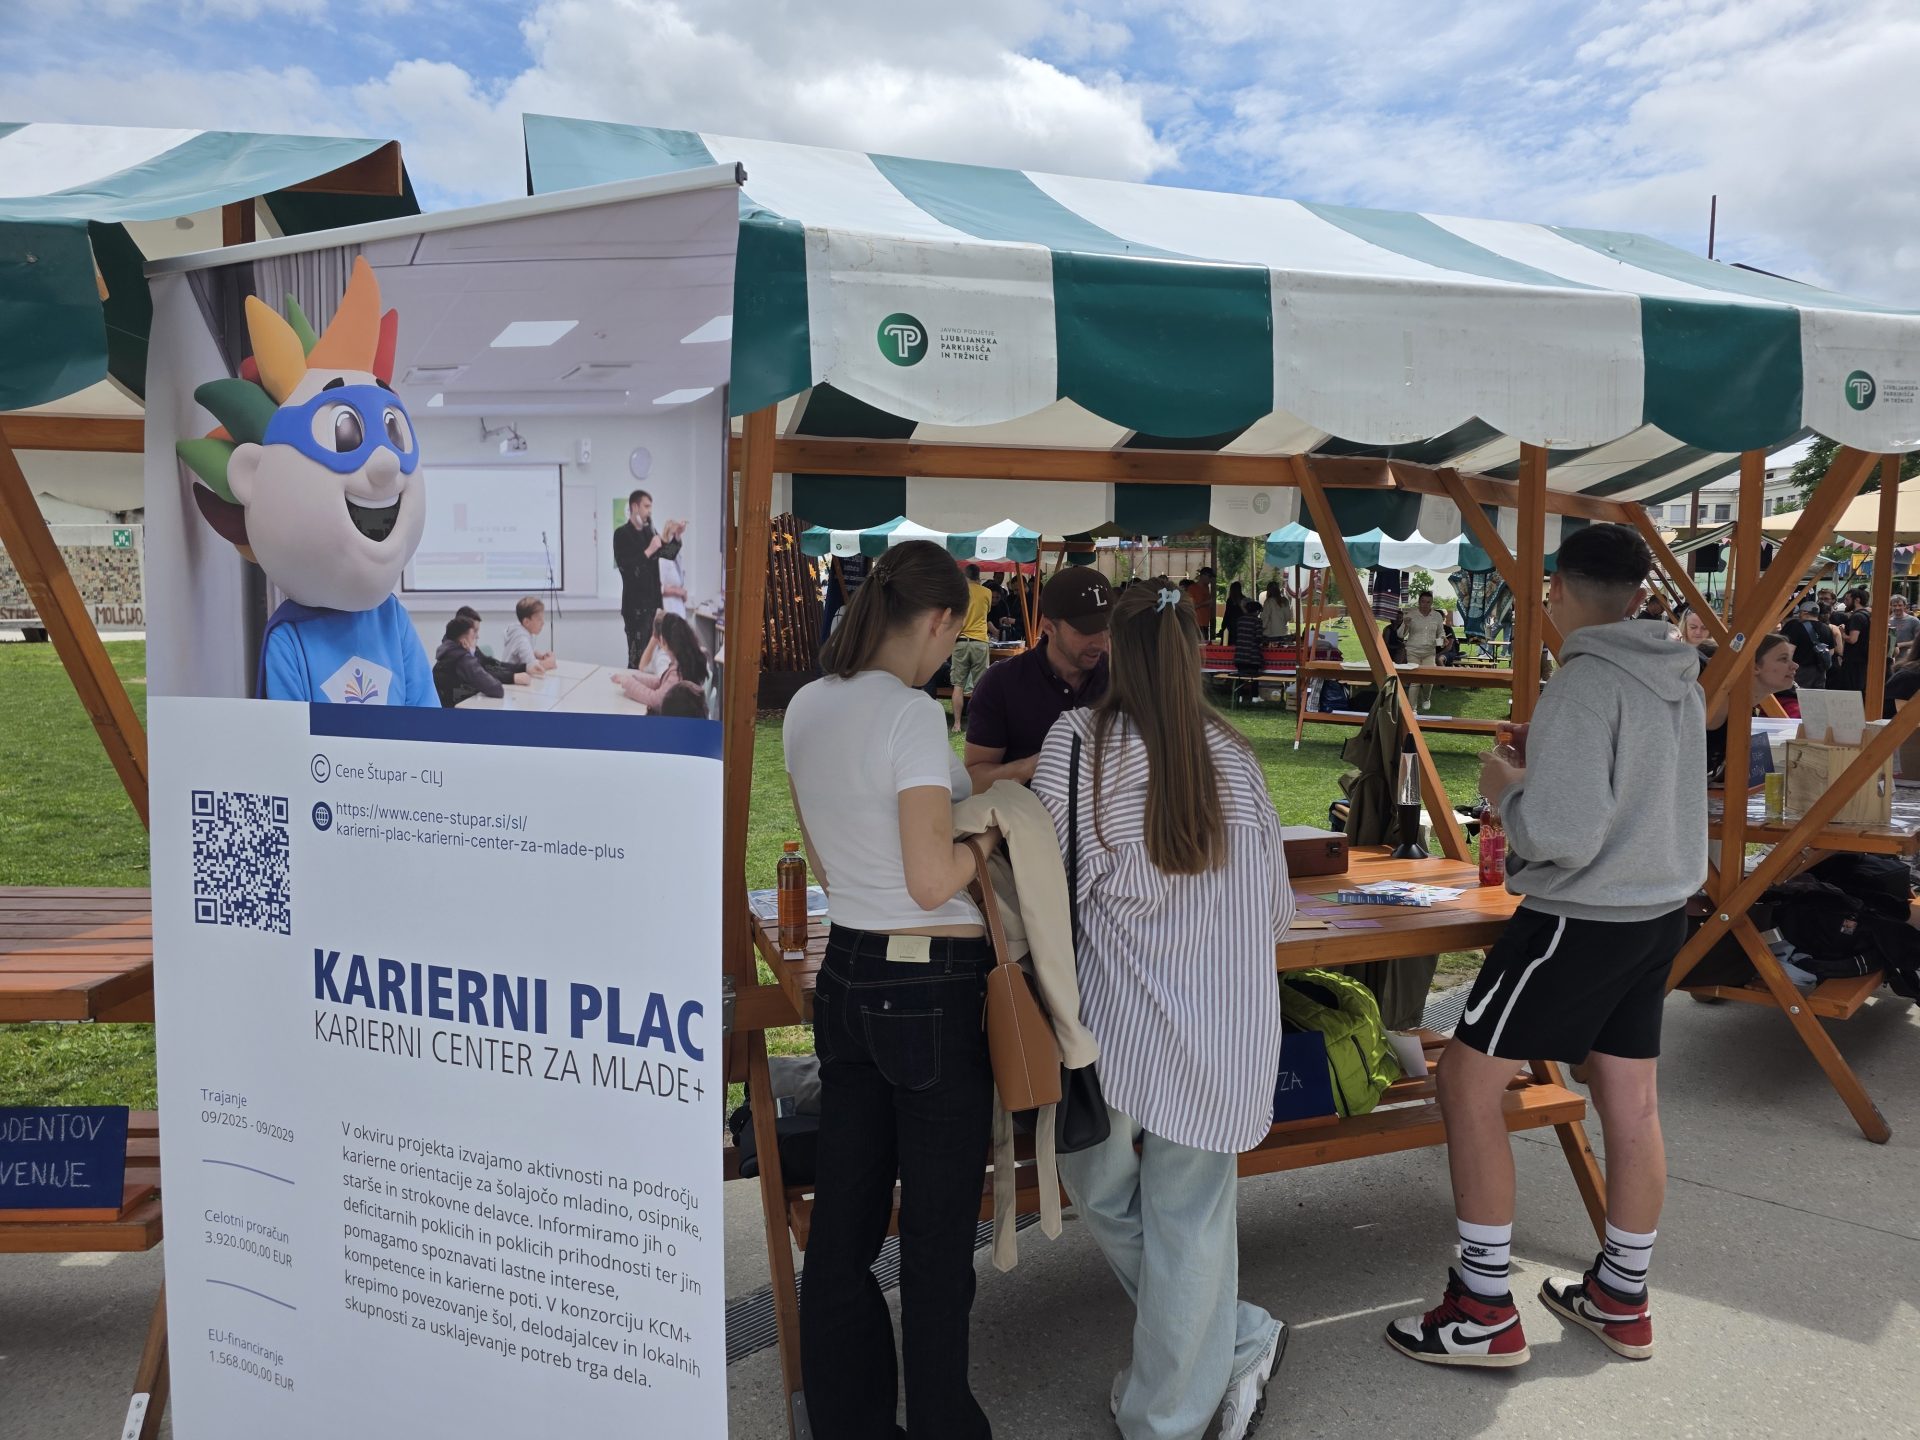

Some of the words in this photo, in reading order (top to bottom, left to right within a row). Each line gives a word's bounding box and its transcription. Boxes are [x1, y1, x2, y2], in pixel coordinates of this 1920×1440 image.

[940, 327, 961, 335] JAVNO
[964, 328, 995, 337] PODJETJE
[940, 334, 998, 345] LJUBLJANSKA
[941, 343, 991, 353] PARKIRIŠČA
[953, 351, 989, 361] TRŽNICE
[1093, 588, 1108, 607] L
[335, 763, 365, 780] Cene
[367, 762, 407, 785] Štupar
[420, 769, 444, 788] CILJ
[335, 801, 528, 831] https://www.cene-stupar.si/sl/
[335, 822, 625, 860] karierni-plac-karierni-center-za-mlade-plus
[313, 948, 547, 1035] KARIERNI
[570, 981, 704, 1062] PLAC
[314, 1009, 422, 1059] KARIERNI
[432, 1030, 533, 1077] CENTER
[543, 1046, 581, 1084] ZA
[592, 1053, 705, 1104] MLADE+
[200, 1088, 247, 1109] Trajanje
[201, 1110, 248, 1129] 09/2025
[256, 1120, 294, 1143] 09/2029
[342, 1121, 350, 1136] V
[354, 1125, 394, 1146] okviru
[398, 1136, 454, 1158] projekta
[459, 1145, 523, 1171] izvajamo
[527, 1160, 603, 1186] aktivnosti
[608, 1175, 628, 1190] na
[633, 1181, 698, 1210] področju
[343, 1146, 396, 1171] karierne
[400, 1162, 472, 1191] orientacije
[476, 1179, 492, 1193] za
[496, 1179, 558, 1205] šolajočo
[563, 1194, 633, 1222] mladino,
[638, 1208, 702, 1242] osipnike,
[204, 1209, 244, 1229] Celotni
[246, 1220, 289, 1244] proračun
[343, 1173, 382, 1194] starše
[386, 1181, 397, 1197] in
[401, 1187, 470, 1214] strokovne
[474, 1201, 533, 1228] delavce.
[538, 1214, 639, 1248] Informiramo
[642, 1234, 662, 1254] jih
[667, 1244, 677, 1257] o
[204, 1231, 271, 1259] 3.920.000,00
[273, 1249, 293, 1268] EUR
[343, 1196, 417, 1228] deficitarnih
[421, 1217, 474, 1241] poklicih
[478, 1228, 492, 1245] in
[496, 1233, 553, 1259] poklicih
[558, 1248, 651, 1278] prihodnosti
[656, 1266, 677, 1285] ter
[680, 1272, 701, 1296] jim
[344, 1223, 418, 1253] pomagamo
[422, 1243, 497, 1272] spoznavati
[501, 1258, 546, 1284] lastne
[550, 1270, 619, 1301] interese,
[1467, 1245, 1489, 1255] NIKE
[344, 1244, 425, 1280] kompetence
[429, 1267, 442, 1284] in
[446, 1271, 505, 1301] karierne
[509, 1290, 542, 1310] poti.
[546, 1295, 557, 1312] V
[561, 1298, 643, 1333] konzorciju
[649, 1318, 692, 1343] KCM+
[345, 1269, 398, 1298] krepimo
[402, 1288, 488, 1324] povezovanje
[492, 1308, 516, 1331] šol,
[521, 1317, 619, 1352] delodajalcev
[623, 1339, 637, 1358] in
[643, 1342, 701, 1379] lokalnih
[345, 1295, 408, 1326] skupnosti
[411, 1316, 426, 1330] za
[430, 1321, 517, 1357] usklajevanje
[521, 1345, 572, 1370] potreb
[576, 1357, 608, 1380] trga
[613, 1365, 652, 1388] dela.
[208, 1328, 284, 1367] EU-financiranje
[209, 1350, 272, 1382] 1.568.000,00
[274, 1373, 294, 1392] EUR
